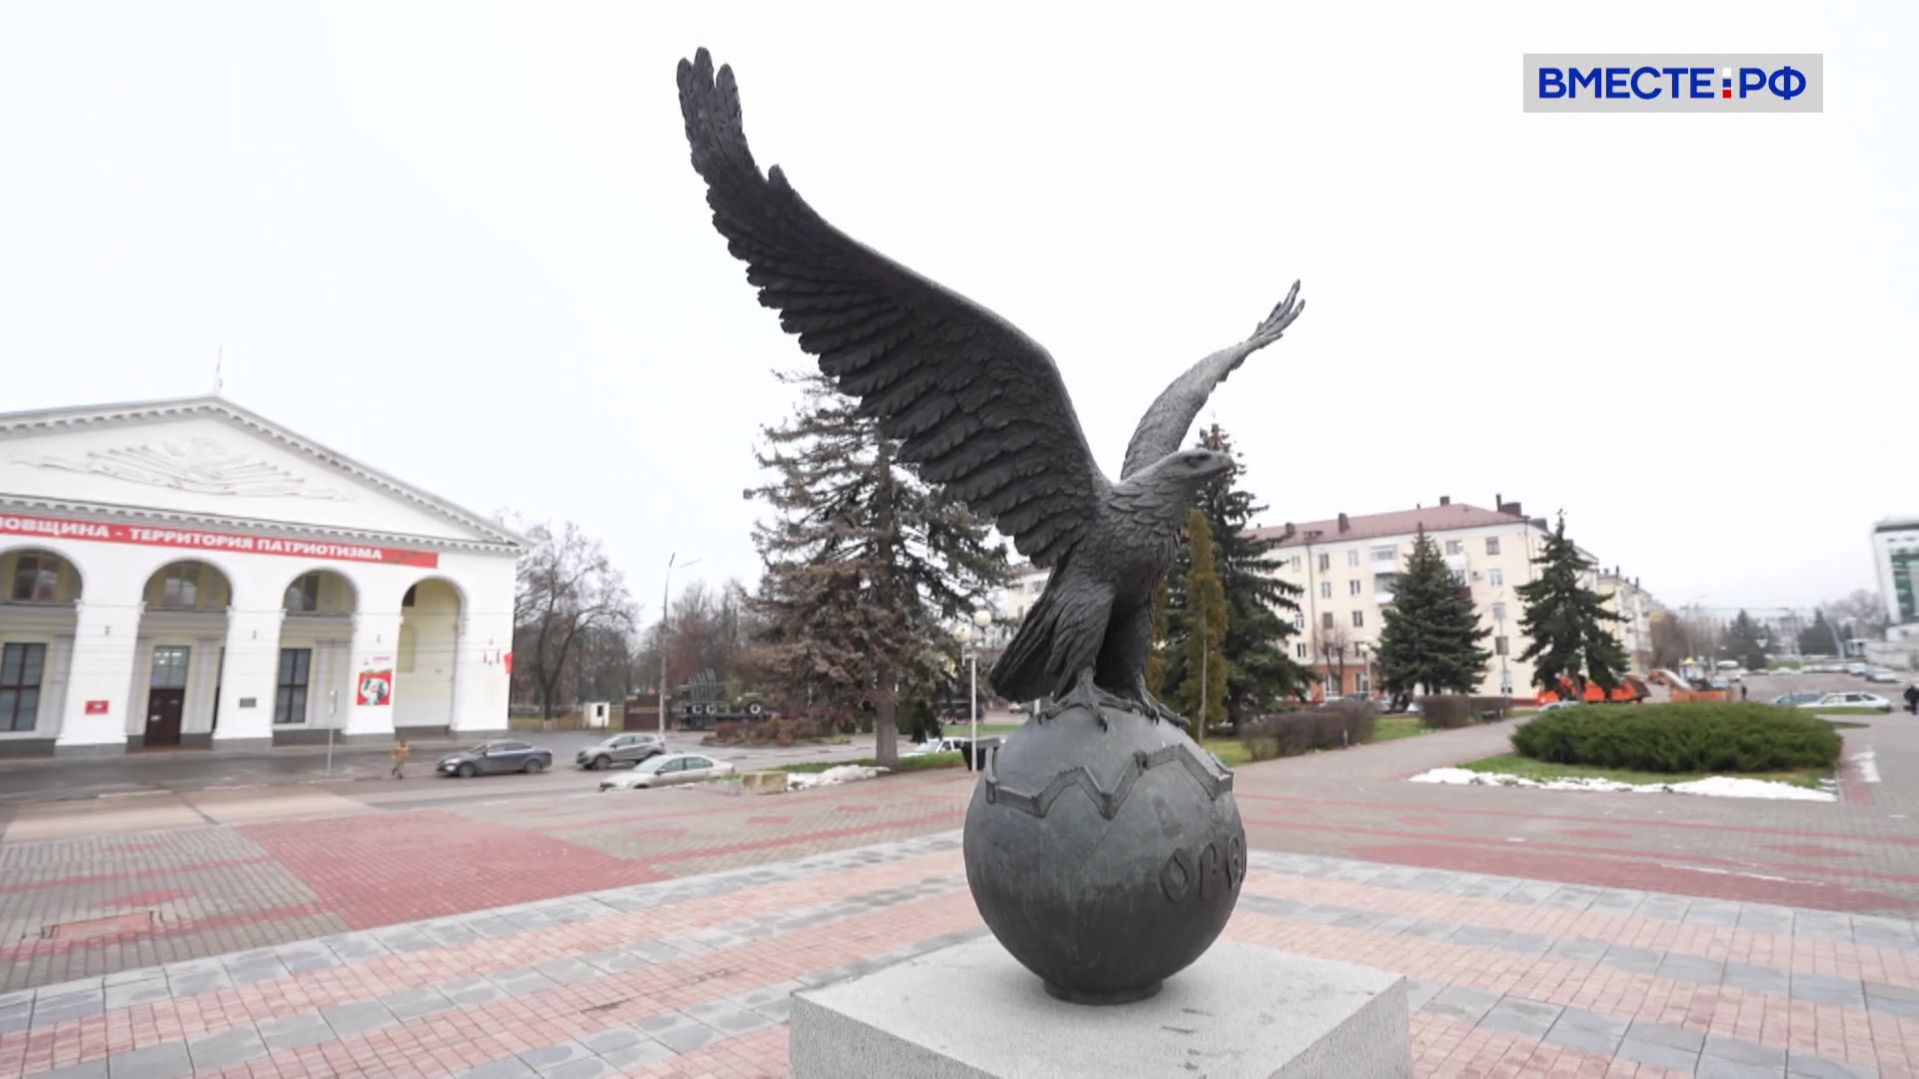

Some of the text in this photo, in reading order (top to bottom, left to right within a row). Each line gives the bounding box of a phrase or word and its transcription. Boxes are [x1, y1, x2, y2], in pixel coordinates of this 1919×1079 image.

[0, 516, 110, 538] ОВЩИНА
[129, 527, 254, 550] ТЕРРИТОРИЯ
[256, 538, 383, 561] ПАТРИОТИЗМА
